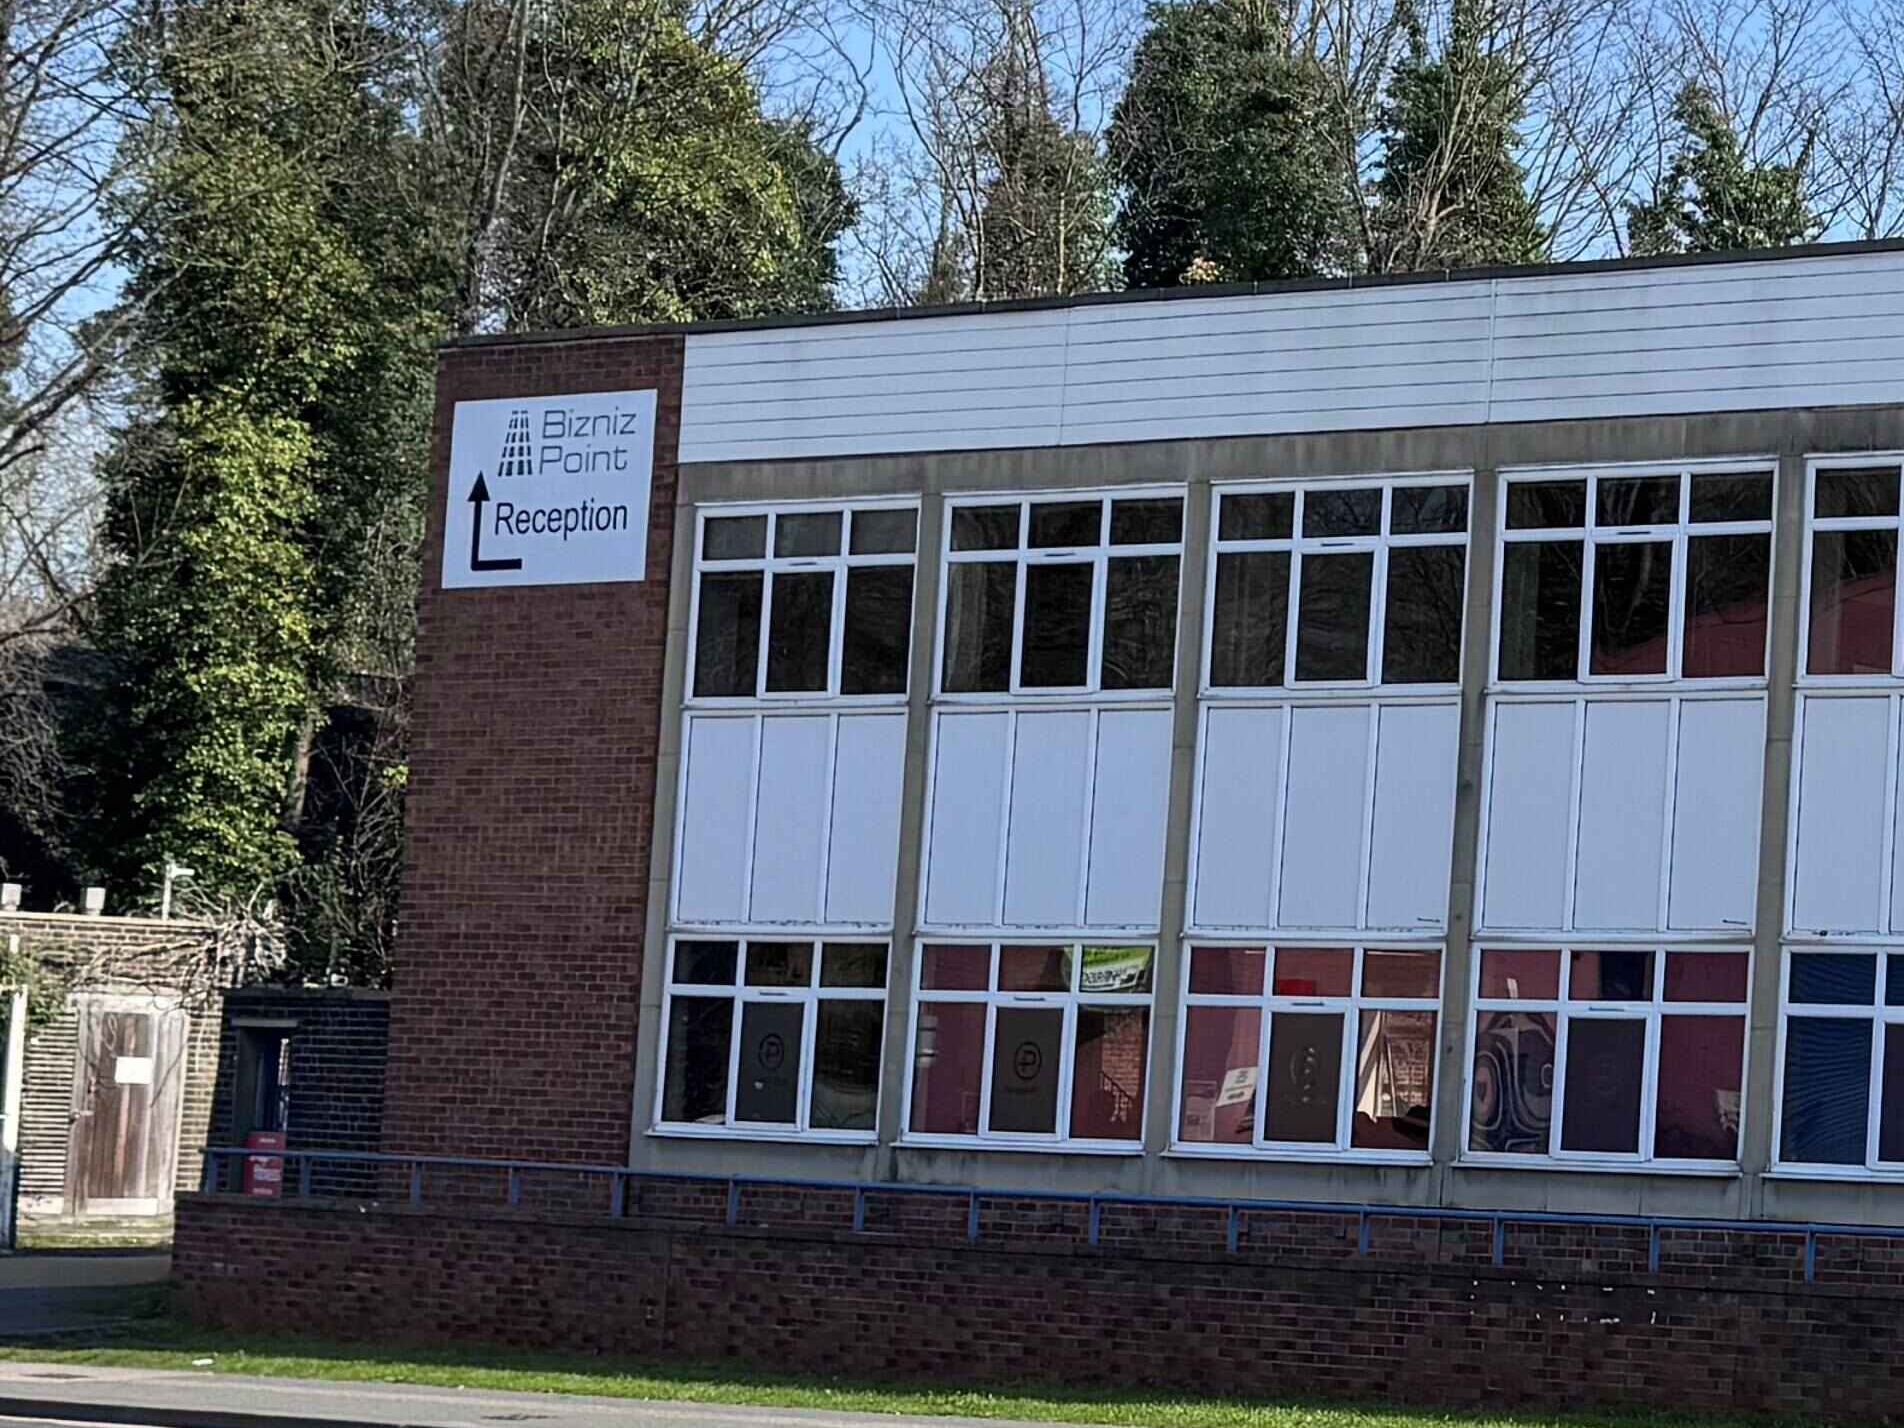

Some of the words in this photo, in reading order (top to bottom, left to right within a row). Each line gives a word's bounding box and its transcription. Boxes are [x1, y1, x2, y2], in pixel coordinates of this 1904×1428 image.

[542, 406, 637, 439] Bizniz
[539, 444, 628, 474] Point
[495, 497, 628, 541] Reception
